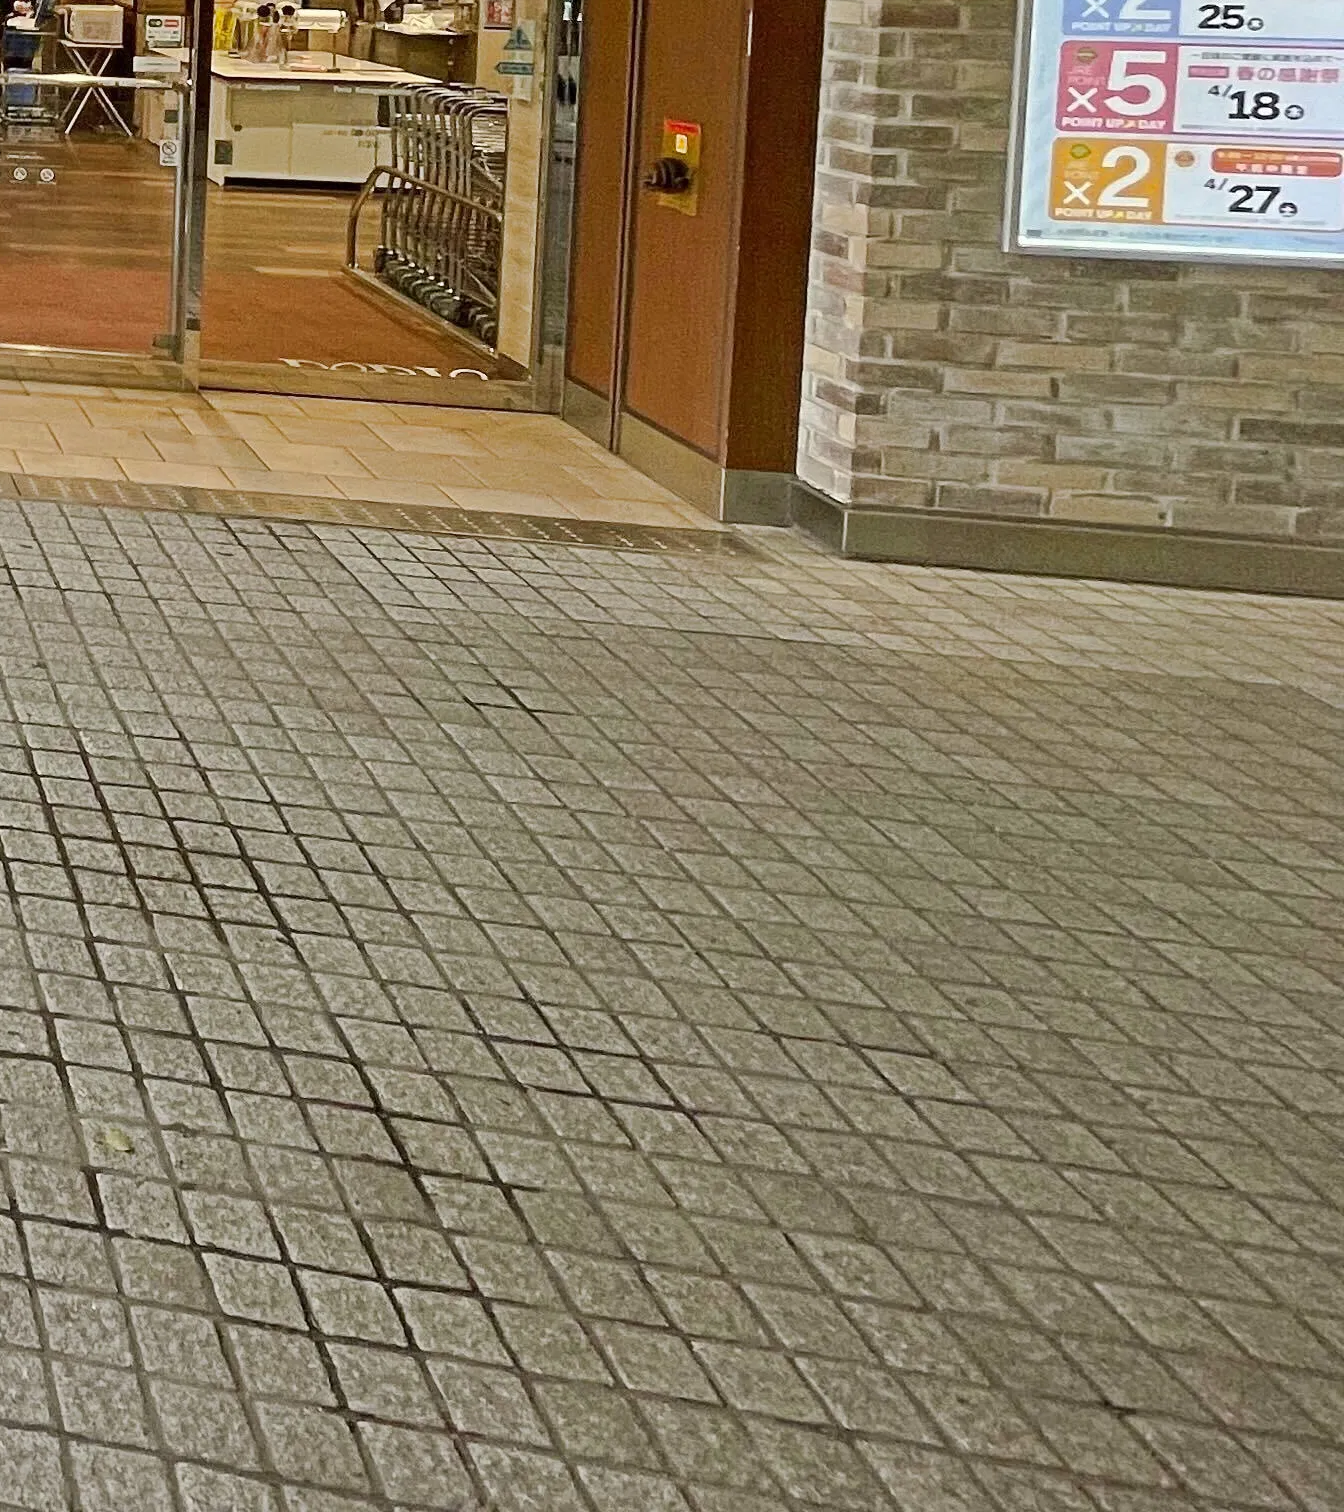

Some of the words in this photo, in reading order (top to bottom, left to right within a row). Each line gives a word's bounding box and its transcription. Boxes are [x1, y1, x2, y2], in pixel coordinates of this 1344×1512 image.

[1198, 4, 1247, 30] 25
[1061, 117, 1103, 128] POINT
[1054, 207, 1093, 218] POINT
